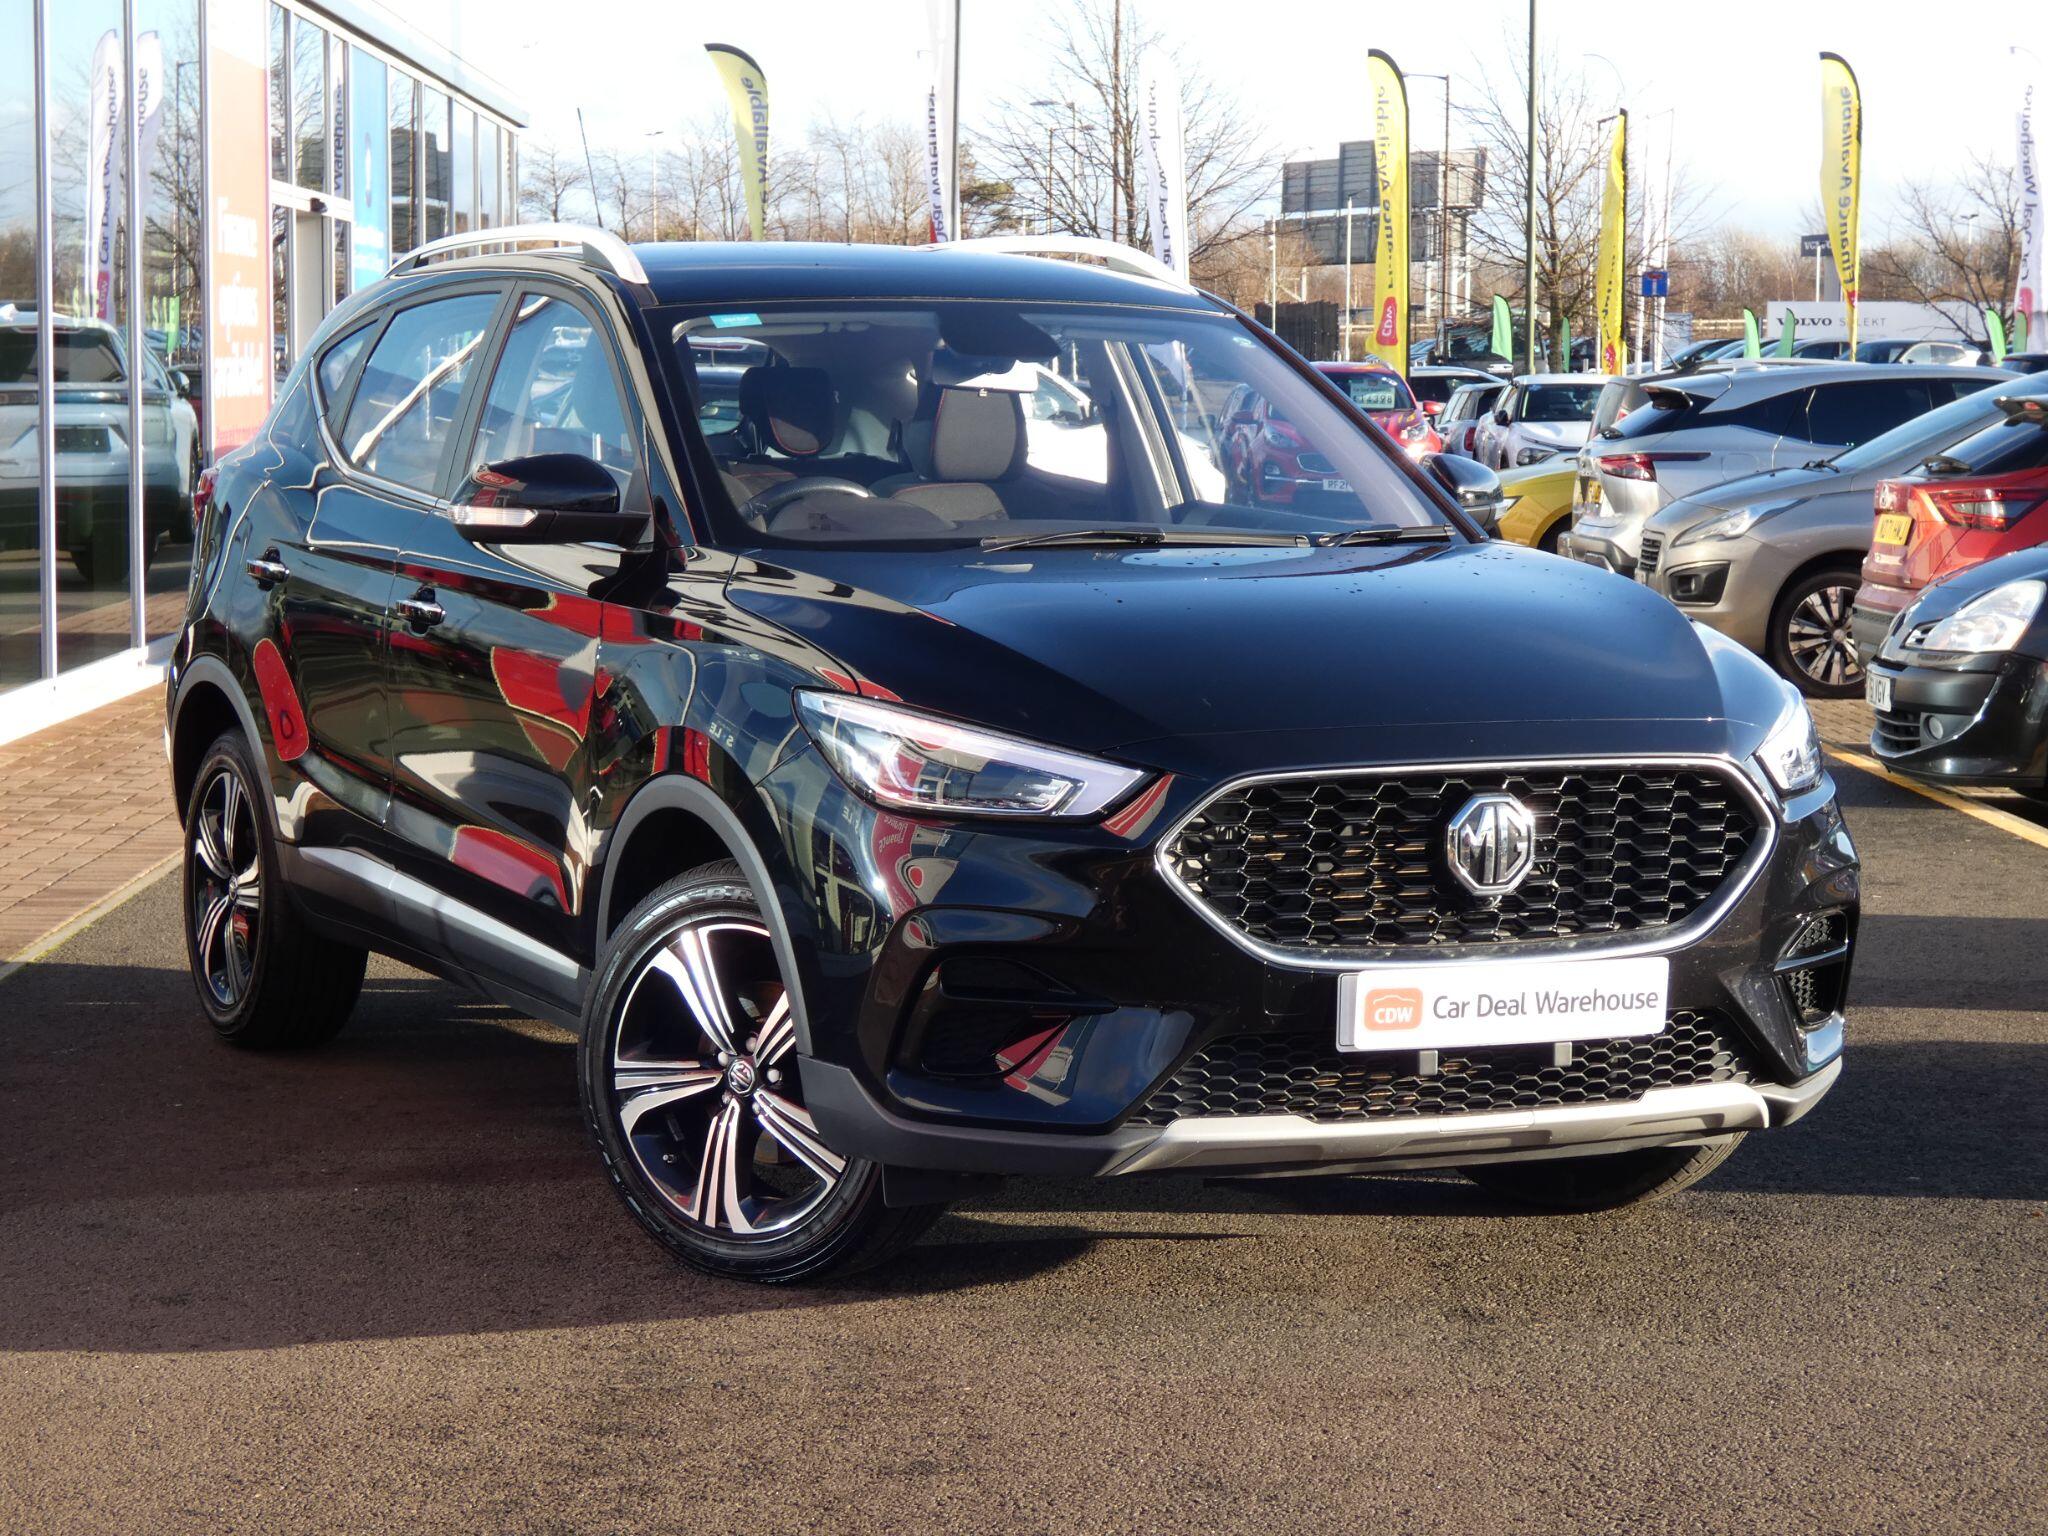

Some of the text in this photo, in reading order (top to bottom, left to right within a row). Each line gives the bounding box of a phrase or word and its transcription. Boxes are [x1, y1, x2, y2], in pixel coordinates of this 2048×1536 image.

[1804, 240, 1831, 250] VOVO
[1776, 317, 1887, 327] VLVO SLEKT
[1460, 805, 1529, 884] MG
[1433, 988, 1659, 1020] Car Deal Warehouse
[1374, 1006, 1413, 1025] CDW
